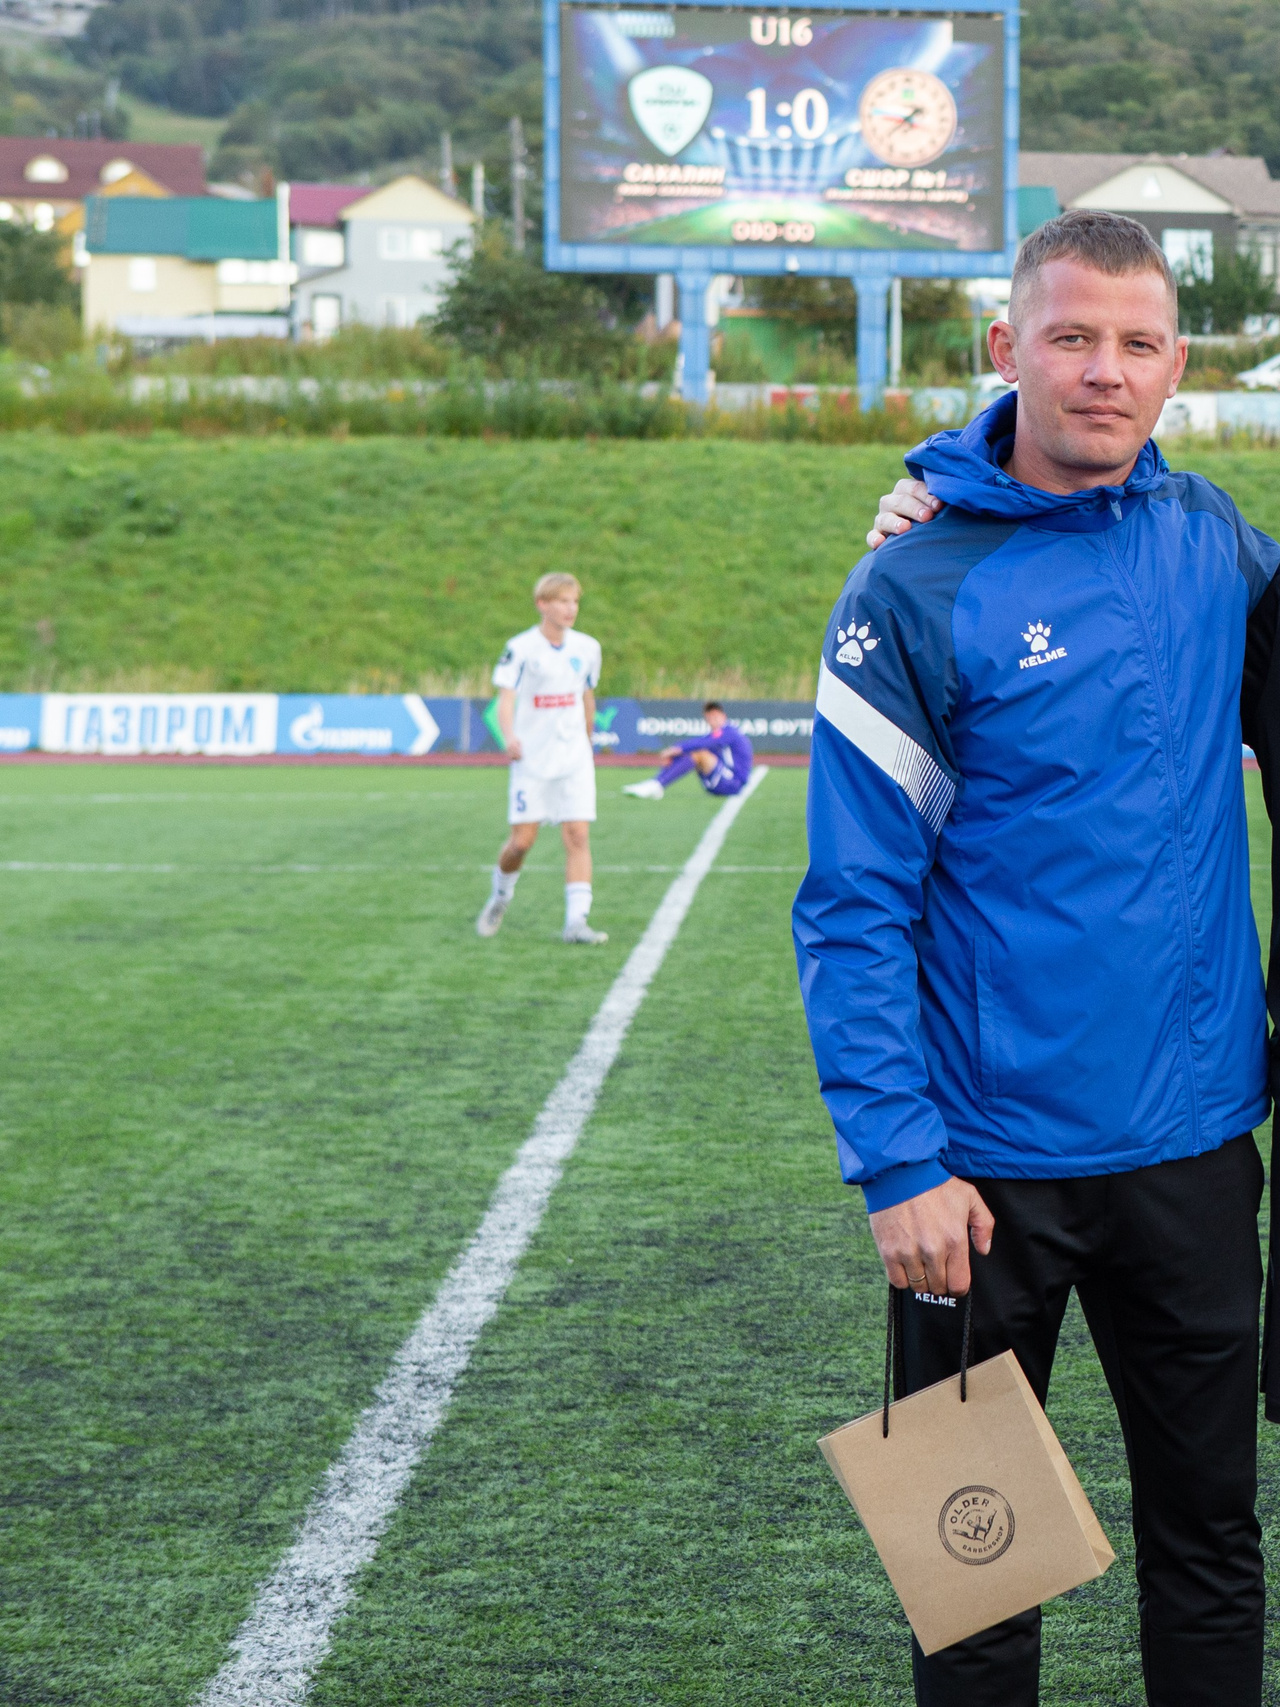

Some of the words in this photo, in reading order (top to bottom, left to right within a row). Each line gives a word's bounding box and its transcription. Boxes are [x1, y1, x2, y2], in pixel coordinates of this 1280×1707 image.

[749, 16, 813, 47] U16
[746, 86, 829, 140] 1:0
[839, 653, 861, 662] KELME
[1019, 647, 1067, 670] KELME
[64, 705, 256, 745] ГАЗПРОМ
[516, 789, 527, 813] 5
[915, 1292, 957, 1307] KELME
[950, 1496, 990, 1525] OLDER
[962, 1525, 1004, 1554] BARBERSHOP
